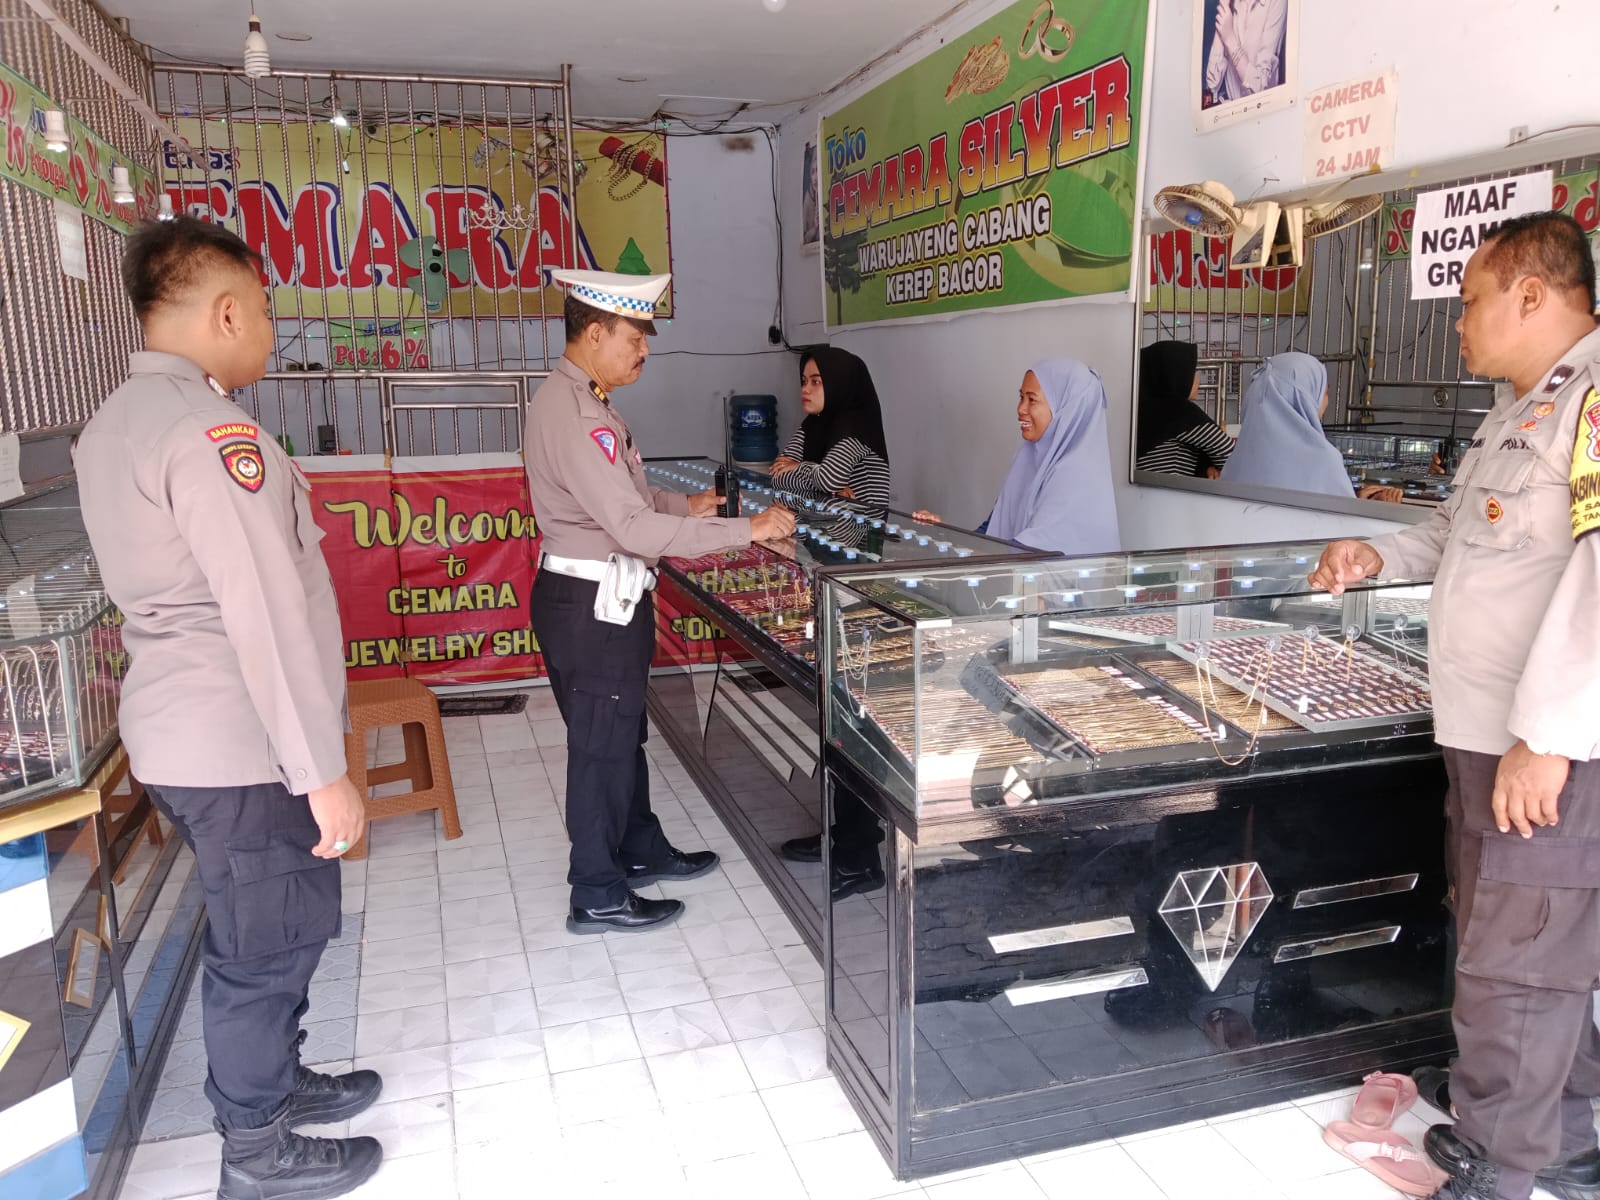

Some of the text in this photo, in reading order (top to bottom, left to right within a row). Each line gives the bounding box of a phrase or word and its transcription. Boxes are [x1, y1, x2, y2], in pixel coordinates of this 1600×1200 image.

[1310, 76, 1386, 114] CAMERA
[829, 54, 1130, 239] CEMARA SILVER
[1320, 113, 1371, 143] CCTV
[826, 127, 867, 175] Toko
[1316, 146, 1381, 177] 24 JAM
[1444, 182, 1518, 219] MAAF
[859, 193, 1051, 274] WARUJAYENG CABANG
[885, 252, 1003, 304] KEREP BAGOR
[437, 553, 468, 579] to
[387, 581, 519, 614] CEMARA
[345, 632, 487, 668] JEWELRY
